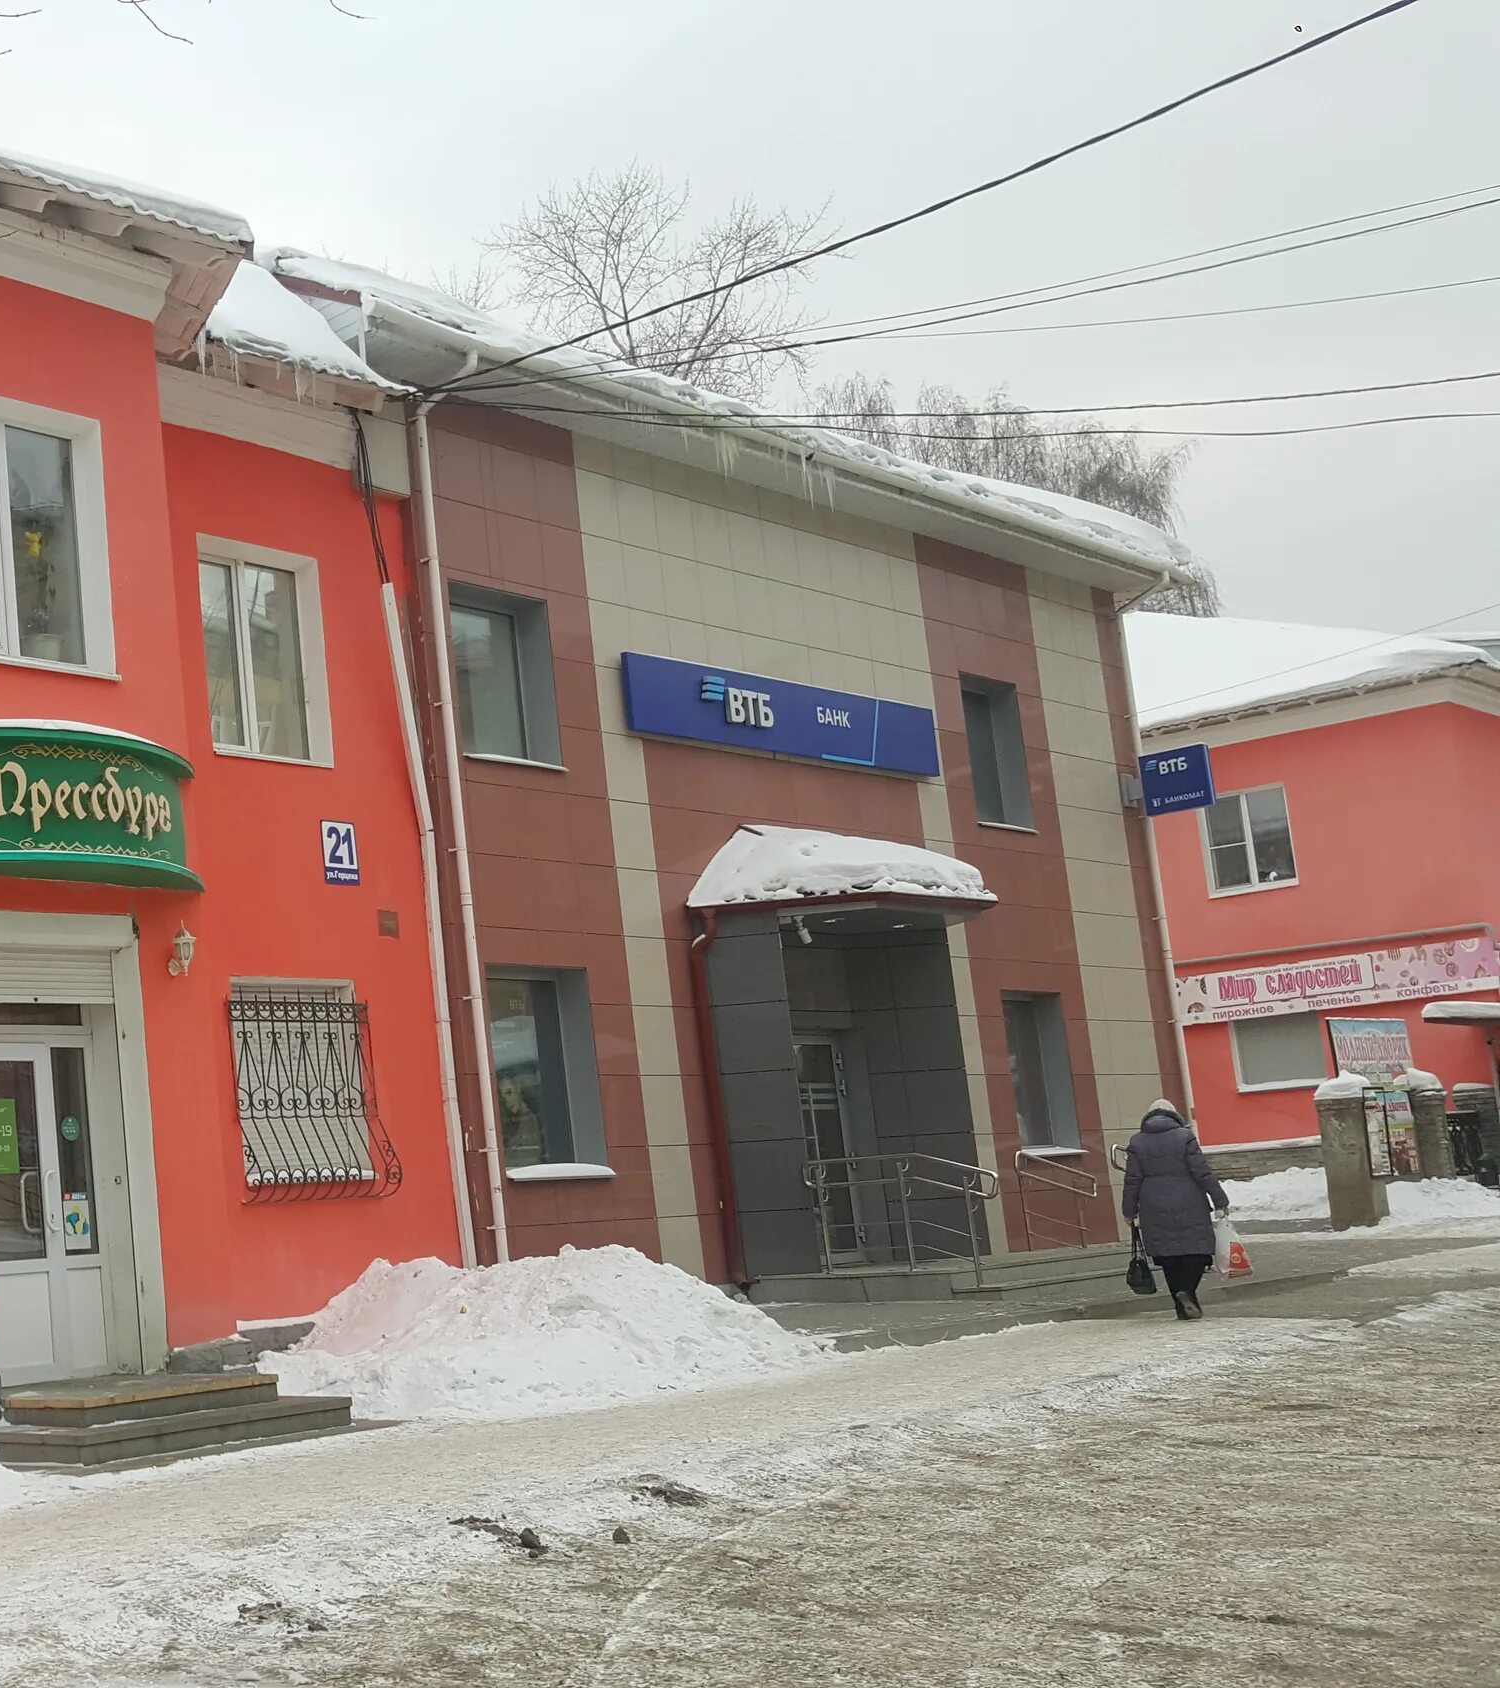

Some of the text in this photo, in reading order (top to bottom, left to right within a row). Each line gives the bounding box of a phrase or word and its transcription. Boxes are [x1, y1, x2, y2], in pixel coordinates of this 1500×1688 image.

[724, 687, 851, 729] ВТБ БАНК
[1158, 757, 1188, 775] ВТБ
[1164, 790, 1205, 804] БАНКОМАТ
[327, 826, 355, 866] 21
[1212, 982, 1459, 1021] пирожное печенье конфеты
[1218, 960, 1363, 1005] Мир сладостей
